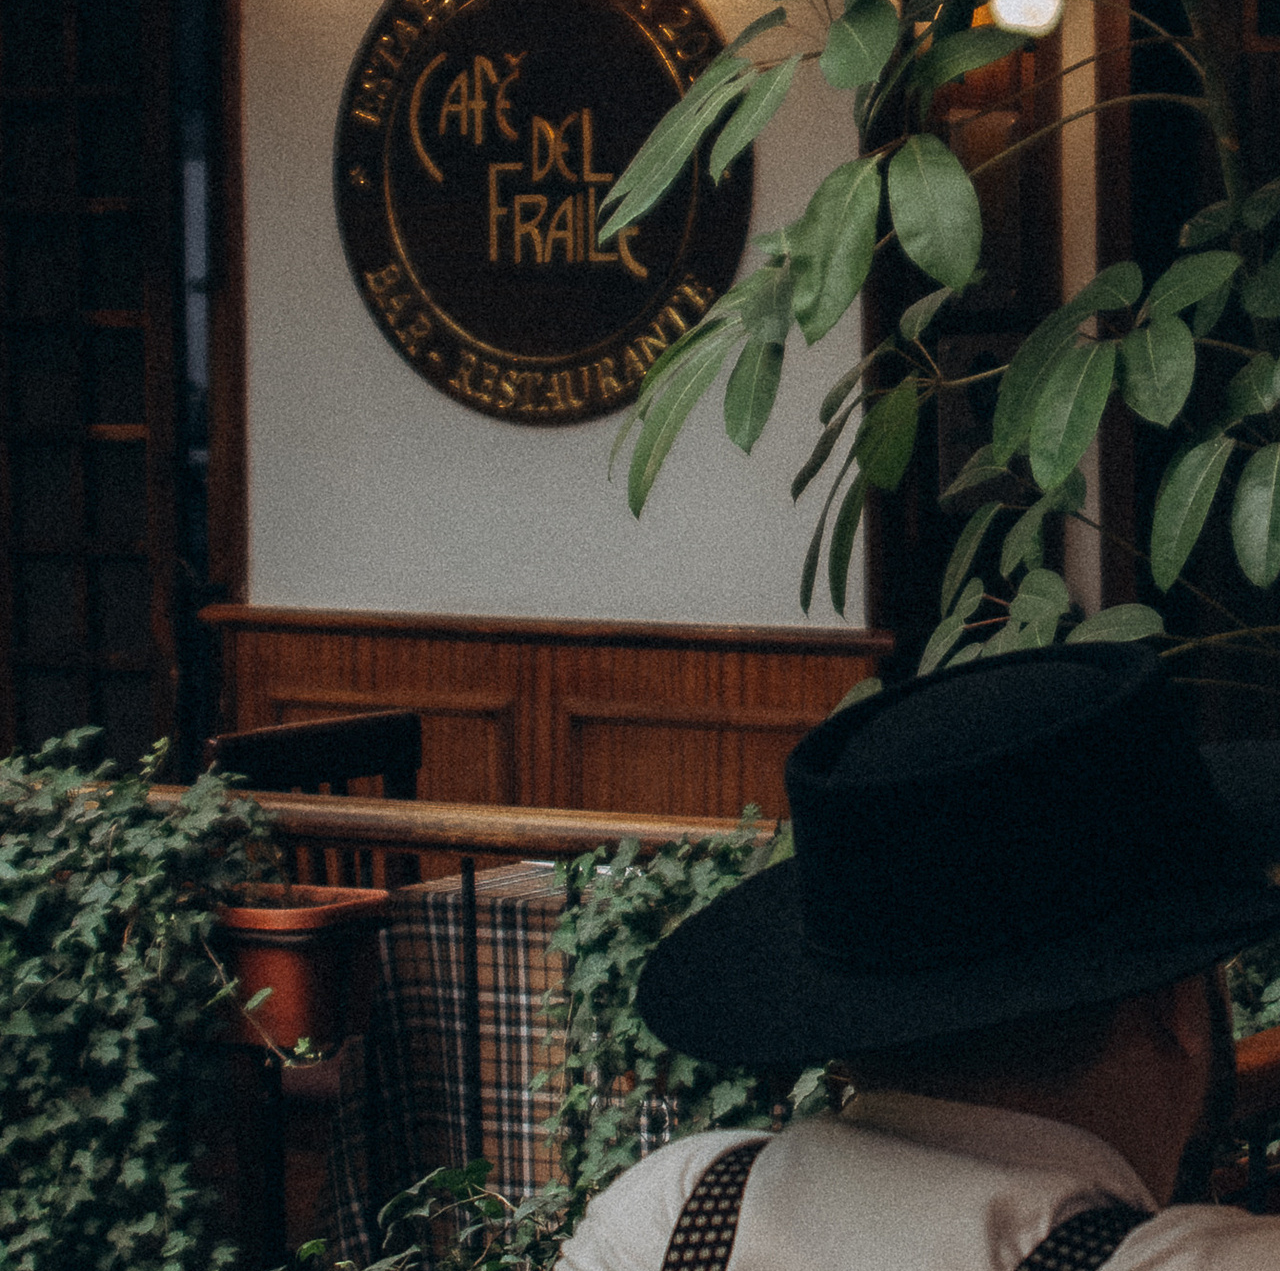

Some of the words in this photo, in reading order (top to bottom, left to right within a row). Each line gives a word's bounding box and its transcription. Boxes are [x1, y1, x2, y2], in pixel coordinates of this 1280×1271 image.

[531, 108, 614, 182] DEL
[364, 263, 433, 357] BAR
[449, 273, 714, 412] RESTAURANTE
